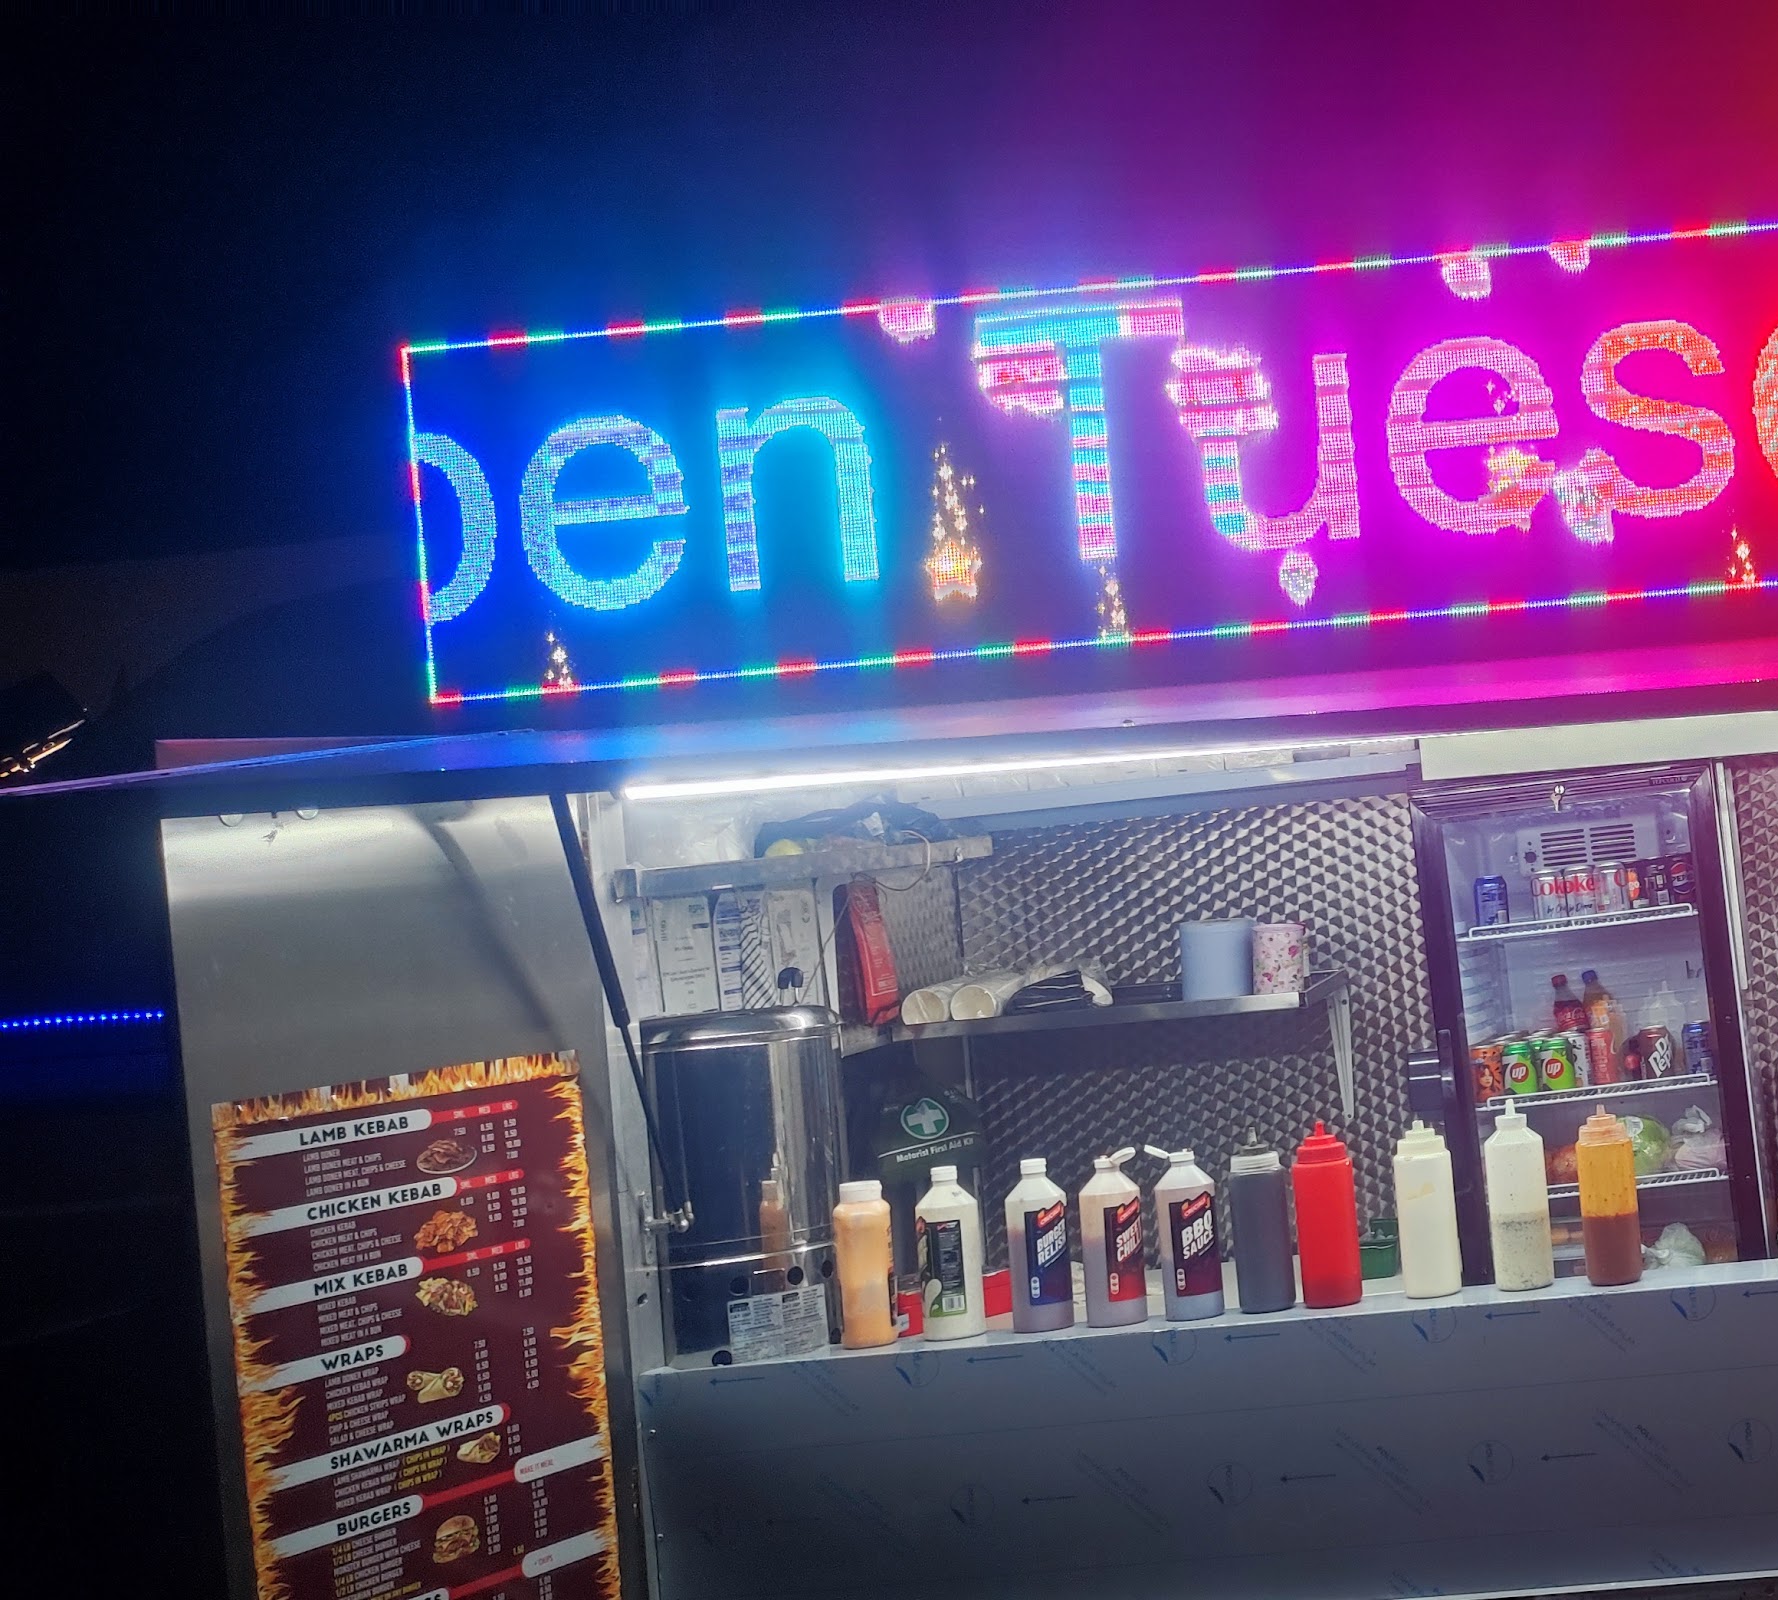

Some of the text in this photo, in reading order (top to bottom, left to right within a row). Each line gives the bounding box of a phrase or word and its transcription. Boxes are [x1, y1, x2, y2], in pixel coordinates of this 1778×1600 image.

[300, 1116, 408, 1145] LAMB KEBAB
[303, 1149, 340, 1162] LAMB DONER
[896, 1138, 973, 1162] Motorist First Aid Kit
[304, 1153, 382, 1174] LAMB DONER MEAT CHIPS
[305, 1175, 321, 1185] LAMB
[323, 1172, 342, 1182] DONER
[361, 1165, 378, 1175] CHIPS
[384, 1160, 406, 1170] CHEESE
[306, 1187, 322, 1197] LAMB
[324, 1183, 343, 1194] DONER
[307, 1183, 442, 1220] CHICKEN KEBAB
[310, 1221, 356, 1237] CHICKEN KEBAB
[311, 1228, 377, 1249] CHICKEN MEAT CHIPS
[1182, 1209, 1212, 1248] BBQ
[312, 1248, 338, 1260] CHICKEN
[357, 1241, 374, 1252] CHIPS
[381, 1234, 402, 1246] CHEESE
[1183, 1229, 1213, 1259] SAUCE
[313, 1260, 338, 1272] CHICKEN
[340, 1255, 355, 1266] MEAT
[314, 1264, 408, 1296] MIX KEBAB
[337, 1296, 356, 1307] KEBAB
[338, 1308, 353, 1318] MEAT
[361, 1303, 378, 1314] CHIPS
[358, 1315, 374, 1326] CHIPS
[381, 1308, 402, 1320] CHEESE
[341, 1331, 356, 1341] MEAT
[321, 1345, 383, 1370] WRAPS
[325, 1367, 379, 1388] LAMB DONER WRAP
[325, 1376, 388, 1399] CHICKEN KEBAB WRAP
[344, 1405, 369, 1418] CHICKEN
[369, 1399, 389, 1411] STRIPS
[389, 1394, 406, 1405] WRAP
[346, 1394, 365, 1405] KEBAB
[366, 1389, 383, 1400] WRAP
[349, 1415, 371, 1428] CHEESE
[372, 1410, 389, 1421] WRAP
[330, 1420, 394, 1446] SALAD CHEESE WRAP
[330, 1411, 493, 1469] SHAWARMA WRAPS
[333, 1474, 350, 1486] LAMB
[351, 1463, 383, 1481] SHAWARMA
[384, 1459, 400, 1471] WRAP
[335, 1484, 360, 1498] CHICKEN
[361, 1477, 379, 1489] KEBAB
[381, 1472, 397, 1483] WRAP
[356, 1490, 374, 1503] KEBAB
[375, 1485, 392, 1497] WRAP
[337, 1501, 411, 1536] BURGERS
